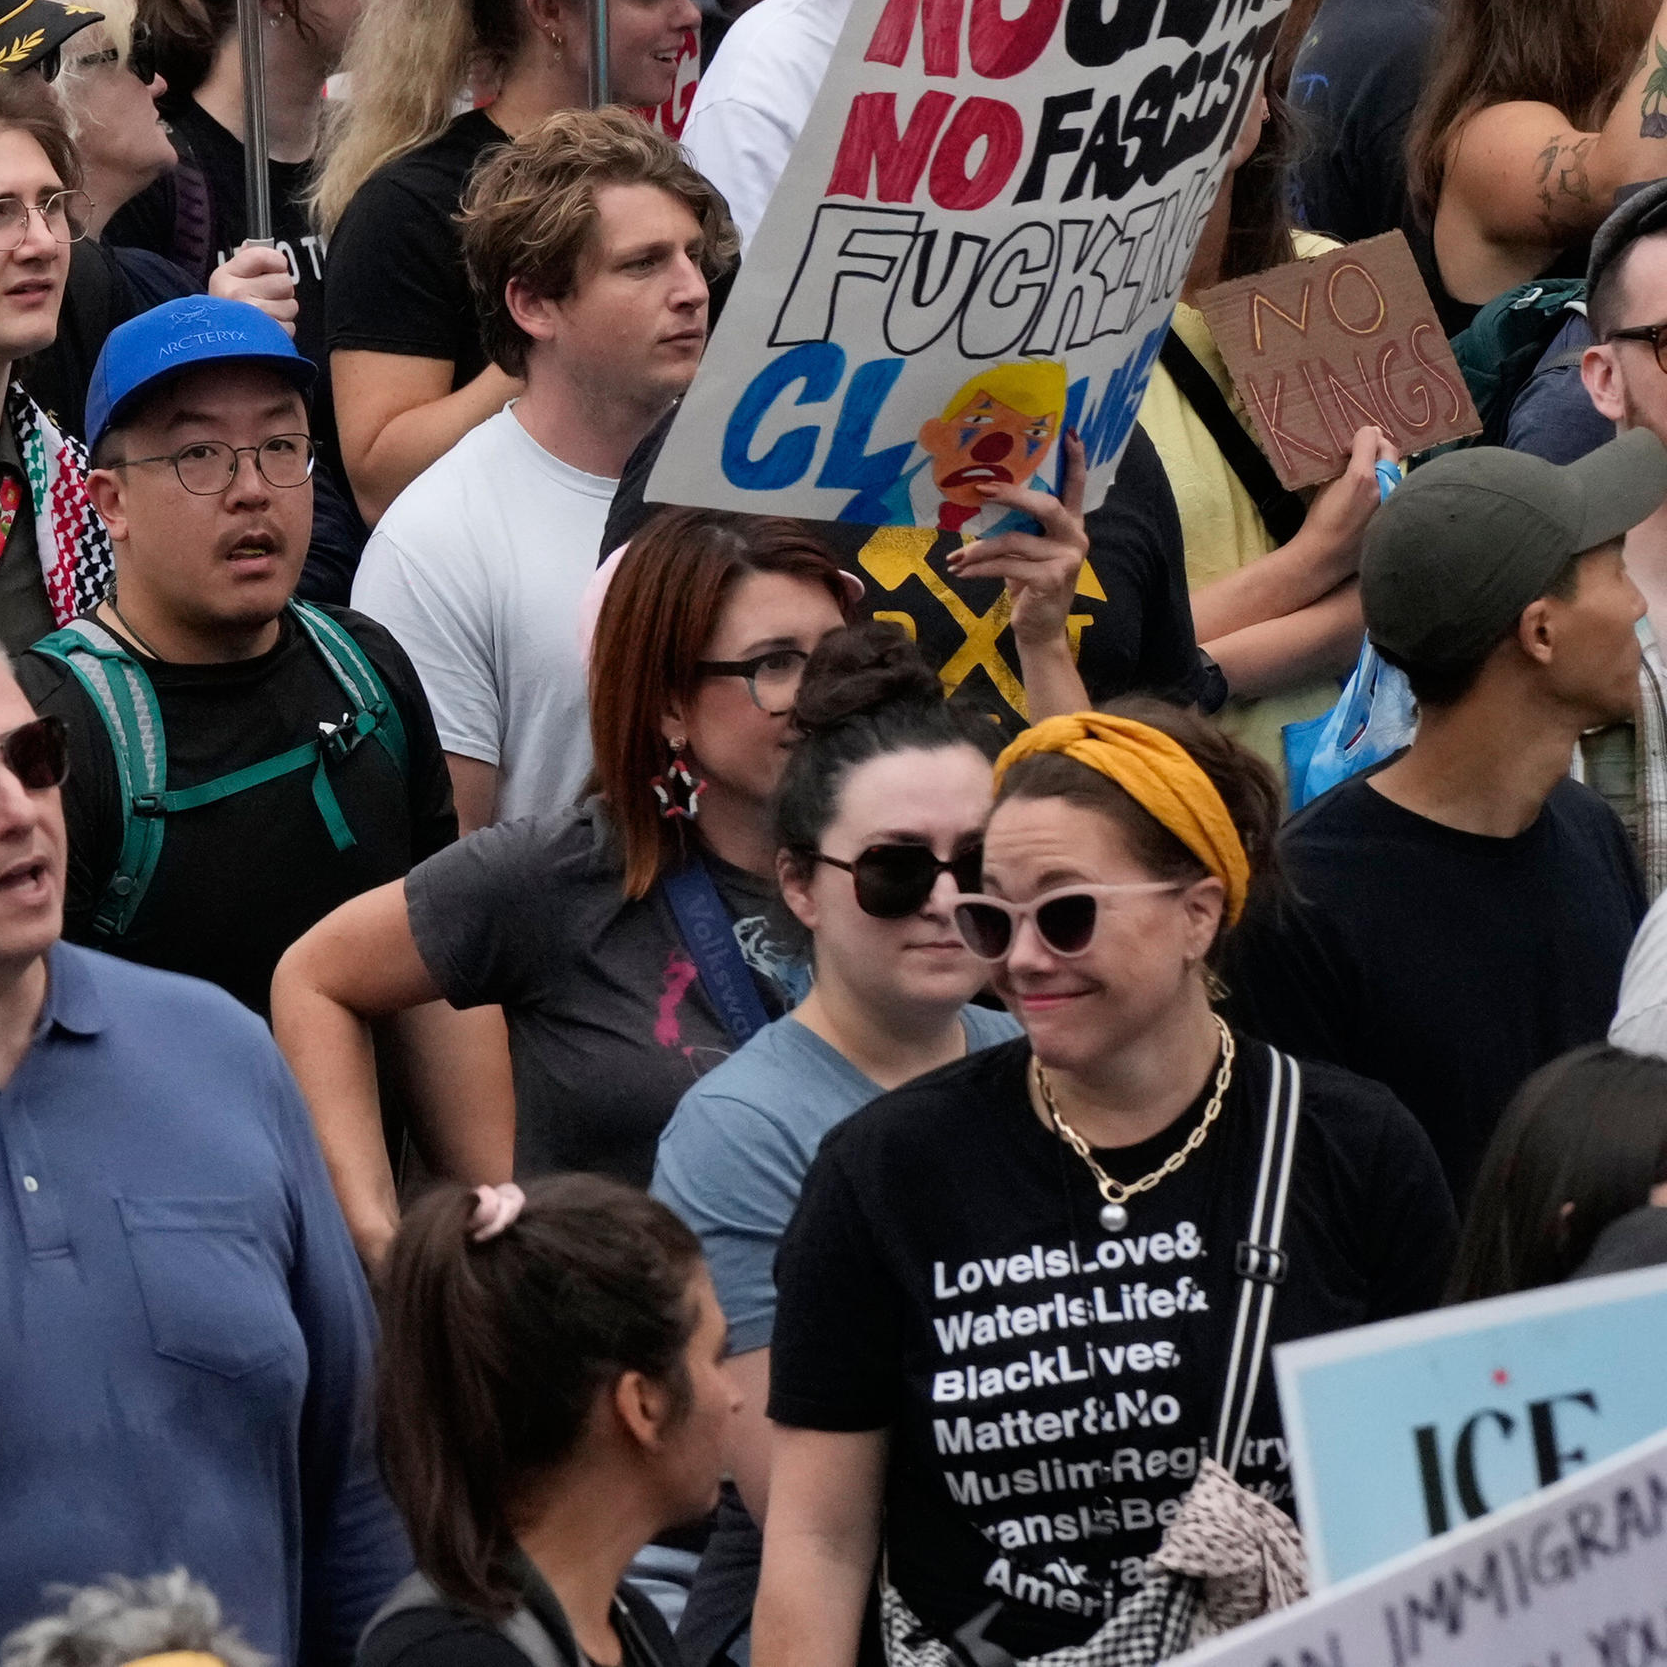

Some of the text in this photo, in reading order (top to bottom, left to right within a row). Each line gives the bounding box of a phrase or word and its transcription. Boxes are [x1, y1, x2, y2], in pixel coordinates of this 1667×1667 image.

[826, 89, 1023, 212] NO
[771, 167, 1216, 362] FUCKING
[1253, 257, 1387, 346] NO
[1261, 321, 1464, 469] KINGS
[932, 1340, 1181, 1403] BlackLives
[933, 1389, 1181, 1455] Matter&No
